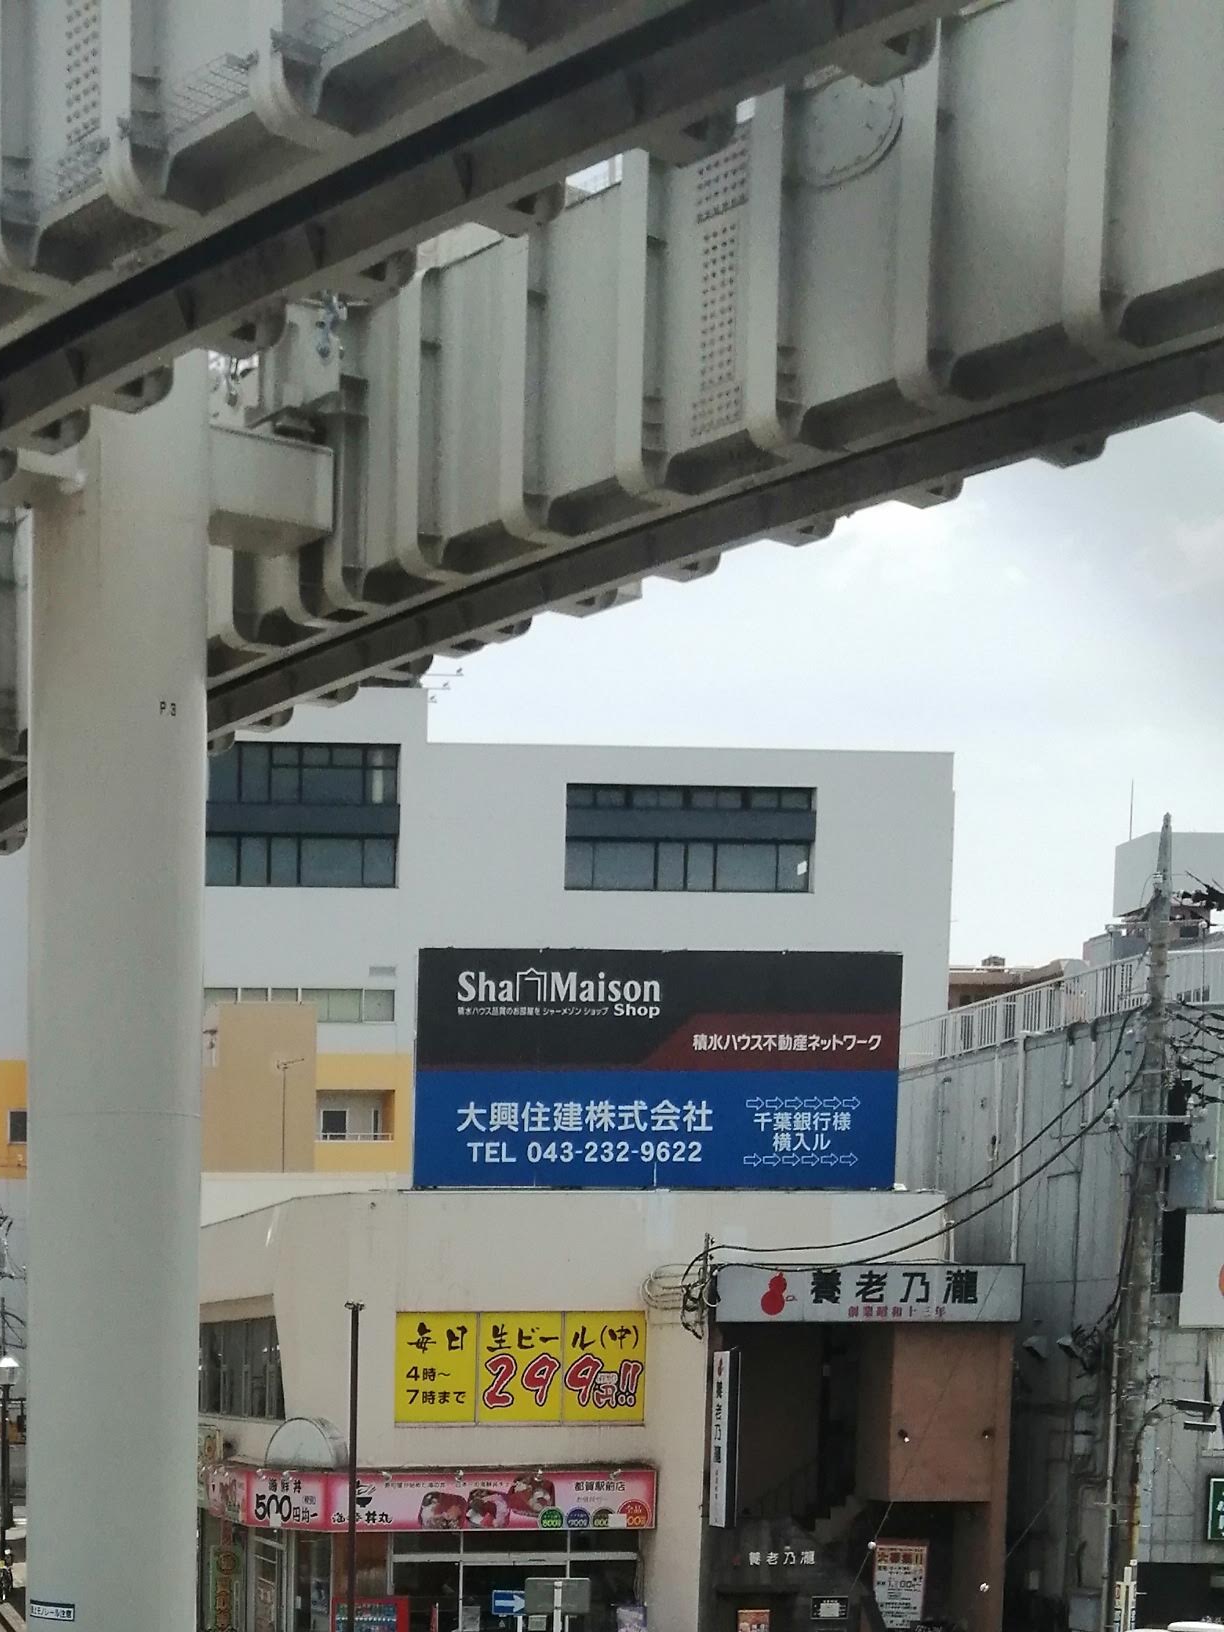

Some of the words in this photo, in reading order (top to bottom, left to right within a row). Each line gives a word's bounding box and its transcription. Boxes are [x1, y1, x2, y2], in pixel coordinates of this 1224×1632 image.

[550, 970, 661, 1002] Maison
[542, 1006, 582, 1016] シャーメゾン
[584, 1006, 609, 1016] ショップ
[613, 1003, 661, 1018] Shop
[692, 1033, 882, 1052] 積水ハウス不動産ネットワーク
[456, 1099, 714, 1133] 大興住建株式会社
[753, 1111, 852, 1132] 千葉銀行様
[467, 1142, 517, 1163] TEL
[527, 1141, 703, 1163] 043-232-9622
[772, 1132, 831, 1152] 横入ル
[407, 1322, 467, 1353] 毎日
[406, 1389, 466, 1405] 7時まで
[574, 1481, 626, 1492] 都賀駅前店
